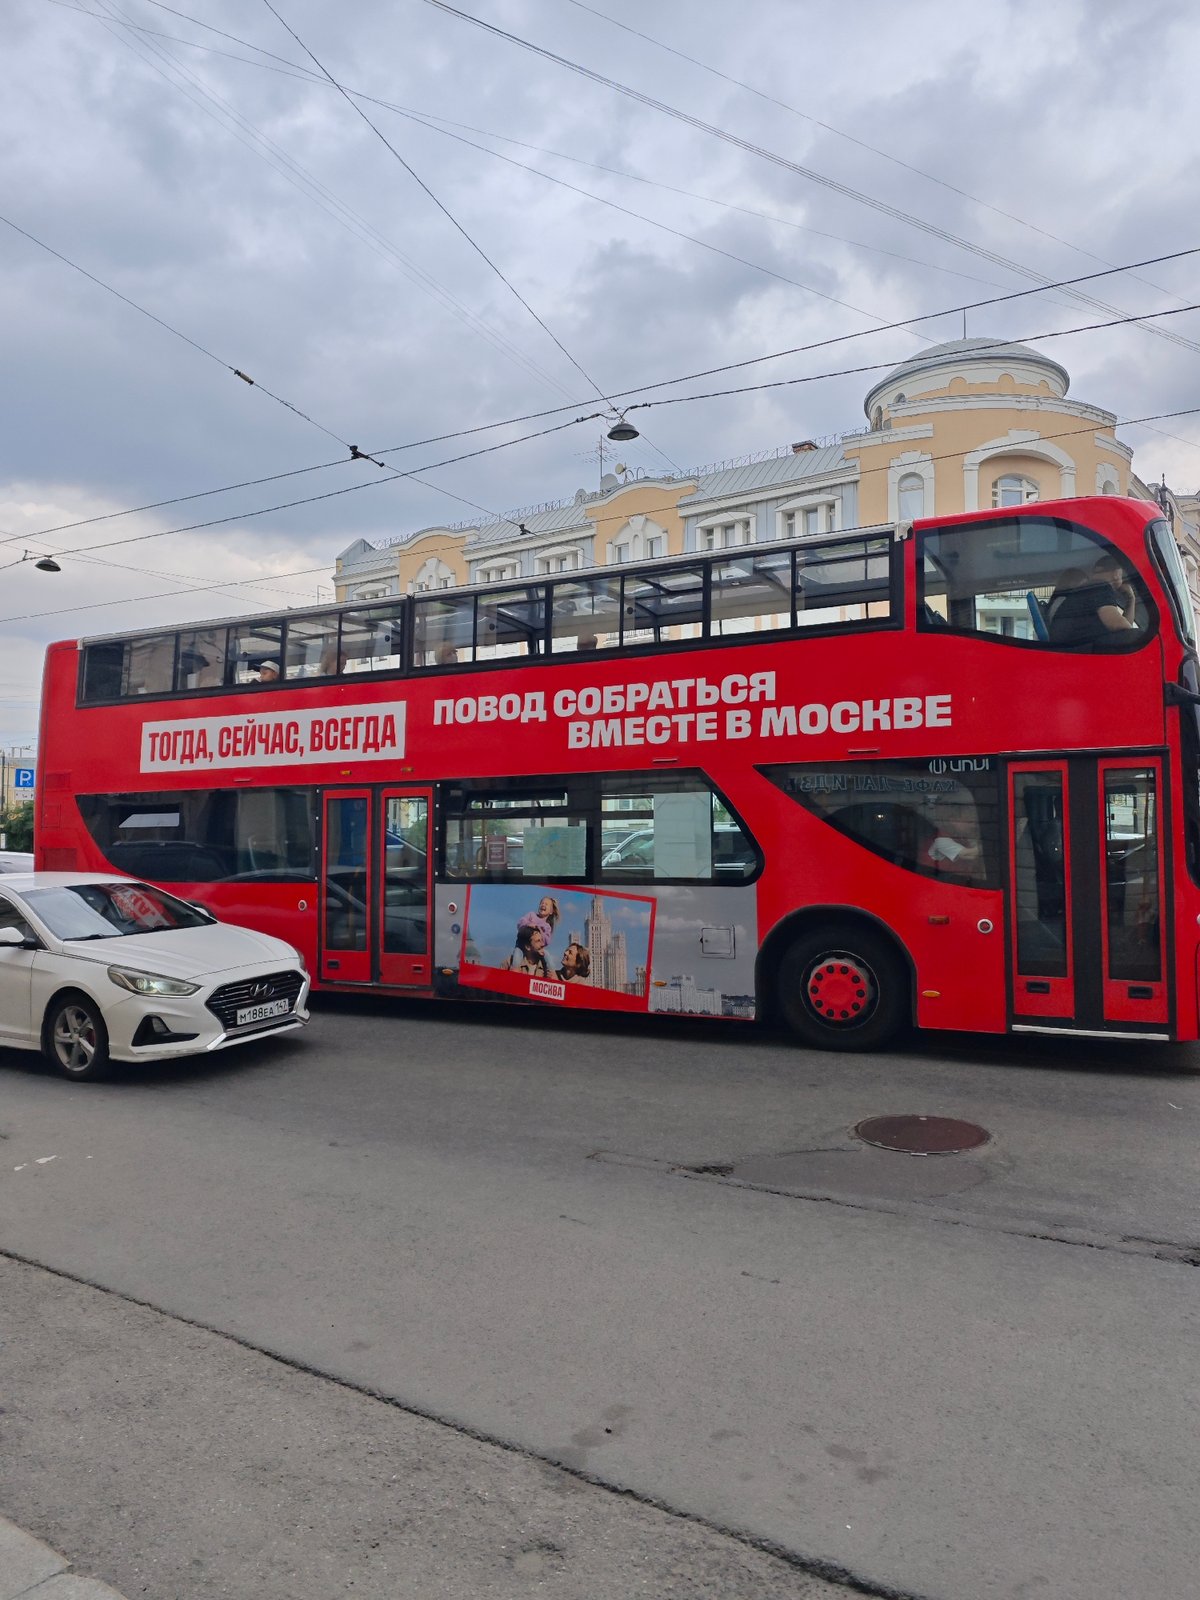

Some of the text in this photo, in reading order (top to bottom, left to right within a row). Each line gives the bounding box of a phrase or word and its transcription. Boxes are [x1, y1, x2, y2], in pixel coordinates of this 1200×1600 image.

[433, 670, 777, 726] ПОВОД СОБРАТЬСЯ
[567, 694, 953, 750] ВМЕСТЕ В МОСКВЕ
[149, 714, 396, 764] ТОГДА, СЕЙЧАС, ВСЕГДА
[20, 770, 32, 786] P
[532, 982, 562, 997] МОСКВА
